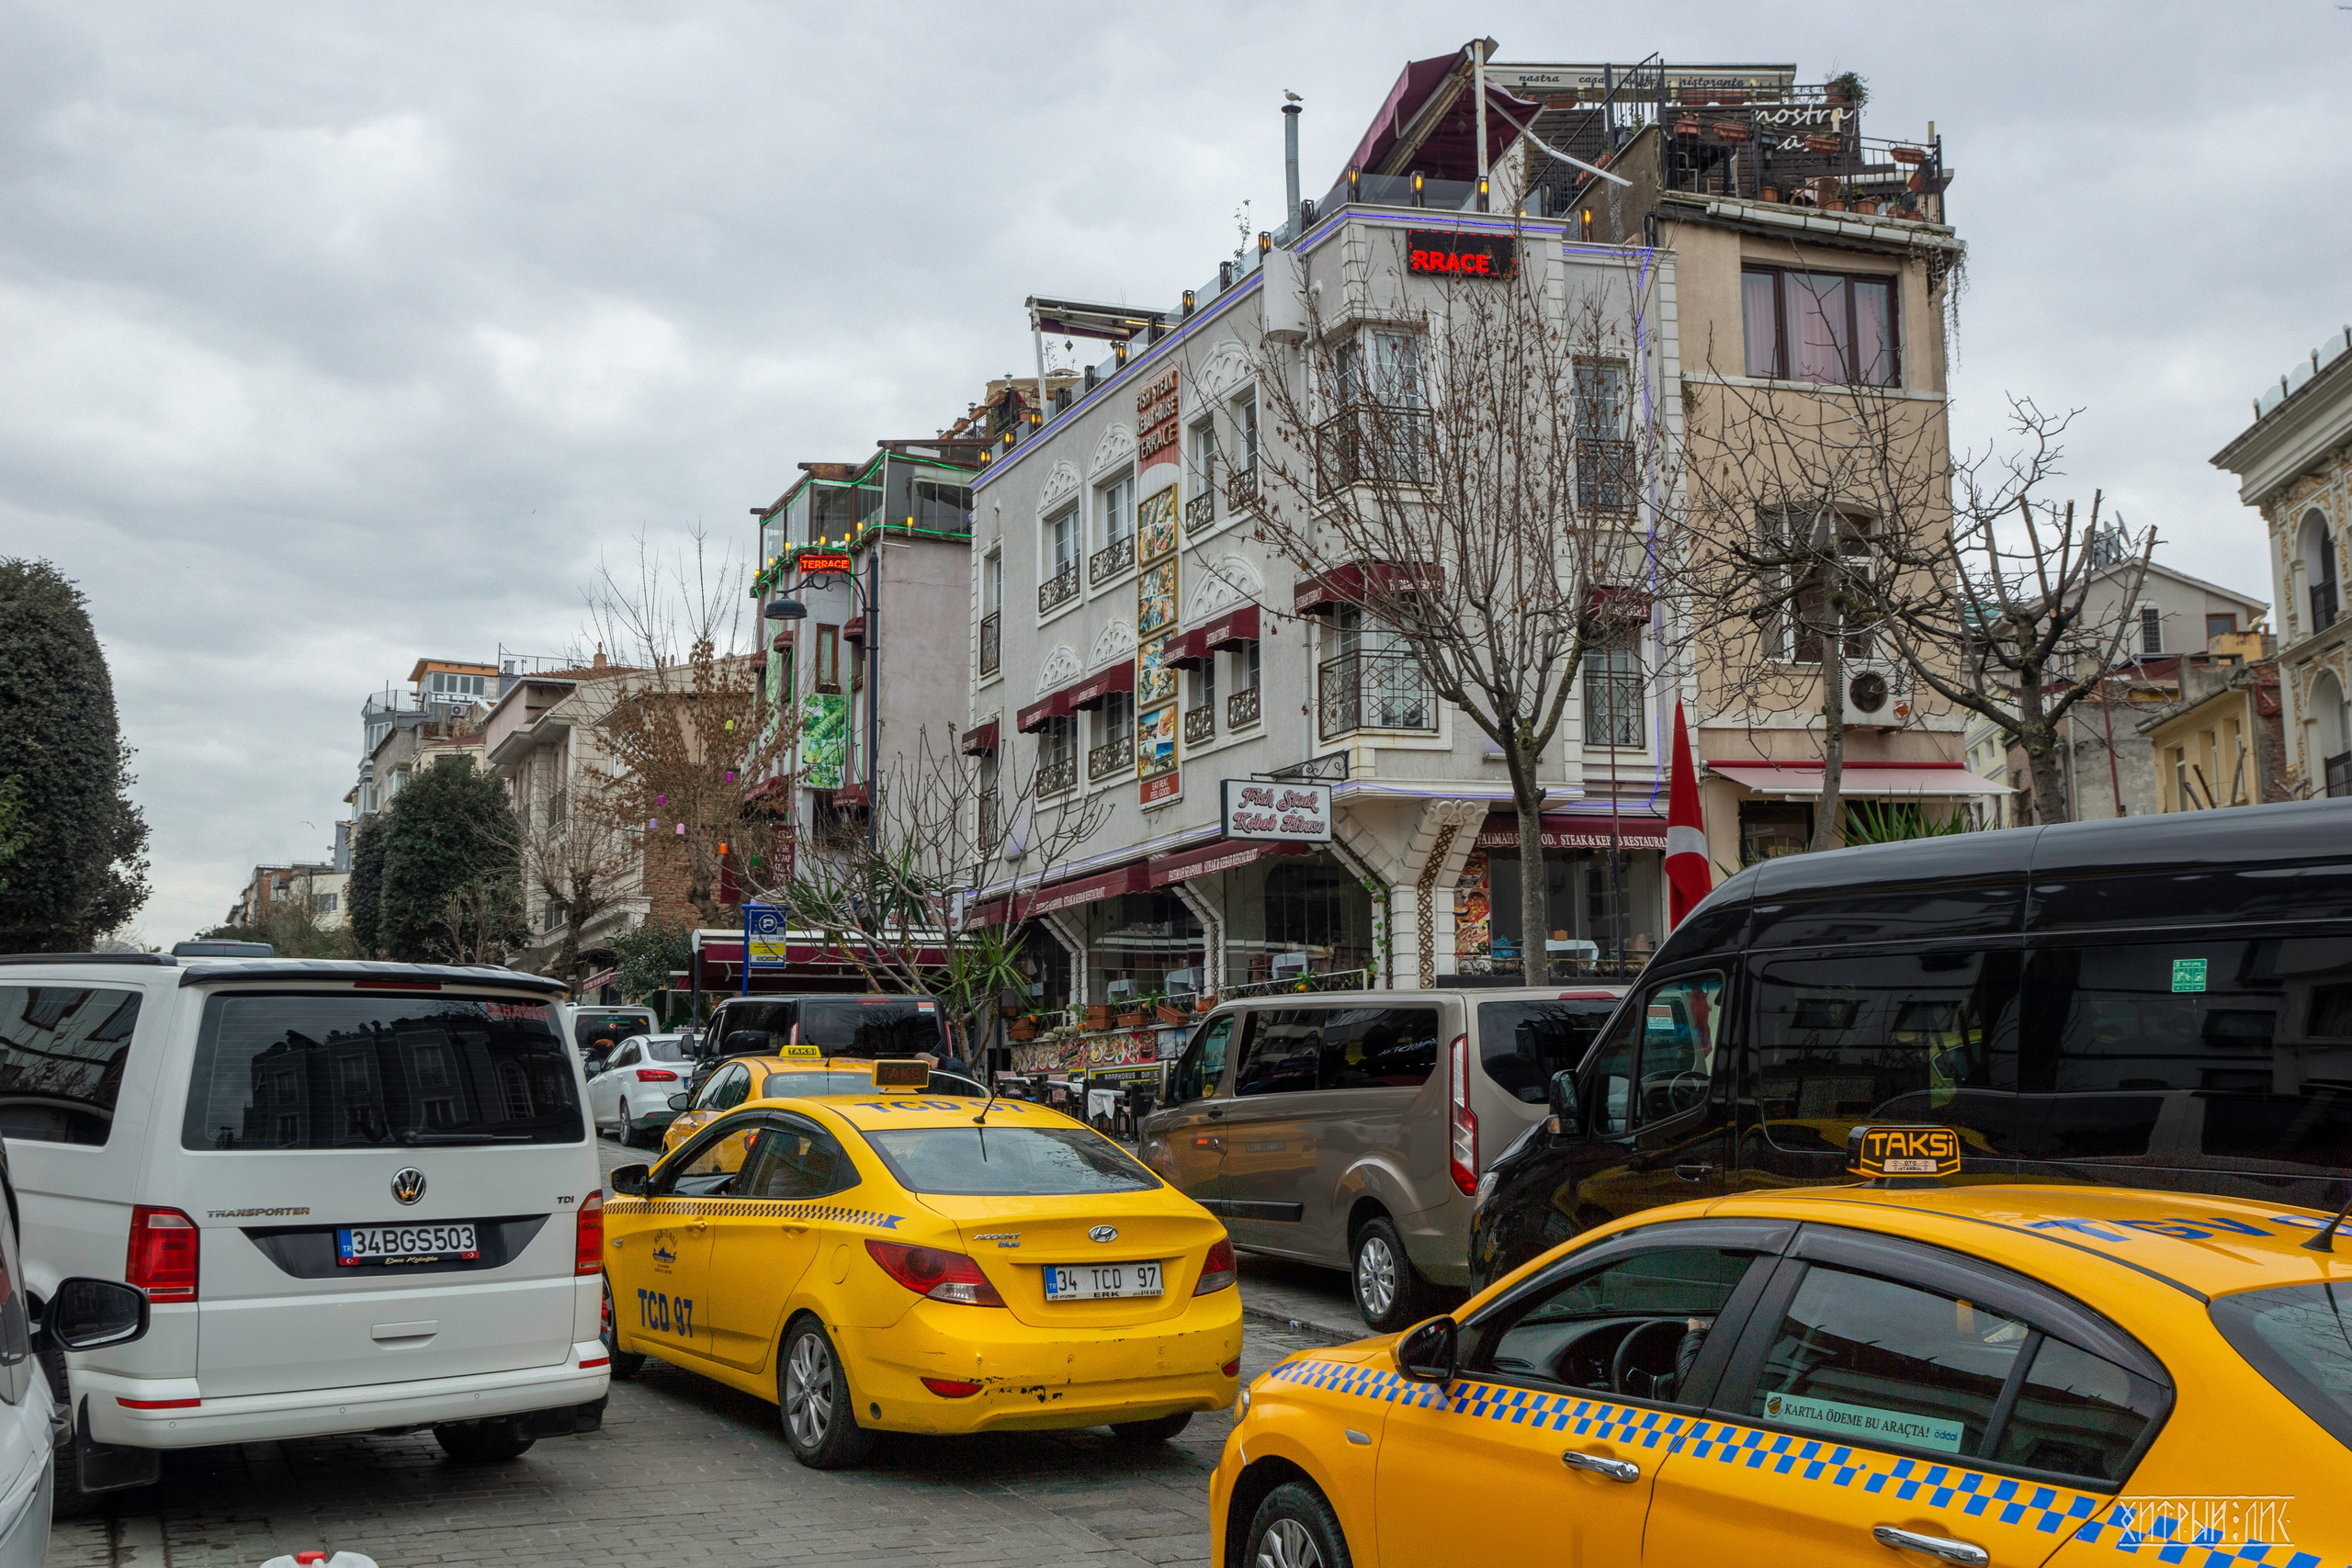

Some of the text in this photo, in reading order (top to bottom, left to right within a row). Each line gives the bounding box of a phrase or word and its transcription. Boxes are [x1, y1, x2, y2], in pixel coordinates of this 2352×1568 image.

[1136, 370, 1178, 412] FISH STEAK
[1155, 396, 1178, 423] HOUSE
[1136, 422, 1177, 461] TERRACE
[801, 559, 848, 569] TERRACE
[1238, 787, 1319, 813] Fish Steak
[1233, 812, 1326, 834] Kebab House
[1561, 834, 1586, 846] STEAK
[1588, 834, 1595, 846] &
[854, 1100, 1026, 1113] TCD 97
[207, 1207, 310, 1218] TRANSPORTER
[352, 1226, 475, 1255] 34BGS503
[974, 1233, 1021, 1241] ACCENT
[2022, 1217, 2276, 1243] TGV
[998, 1239, 1020, 1247] blue
[1057, 1267, 1157, 1292] 34 TCD 97
[638, 1288, 693, 1338] TCD 97
[1784, 1404, 1823, 1421] KARTLA
[1826, 1408, 1862, 1427] ÖDEME
[1865, 1416, 1880, 1429] BU
[1881, 1420, 1930, 1438] ARAÇTA!
